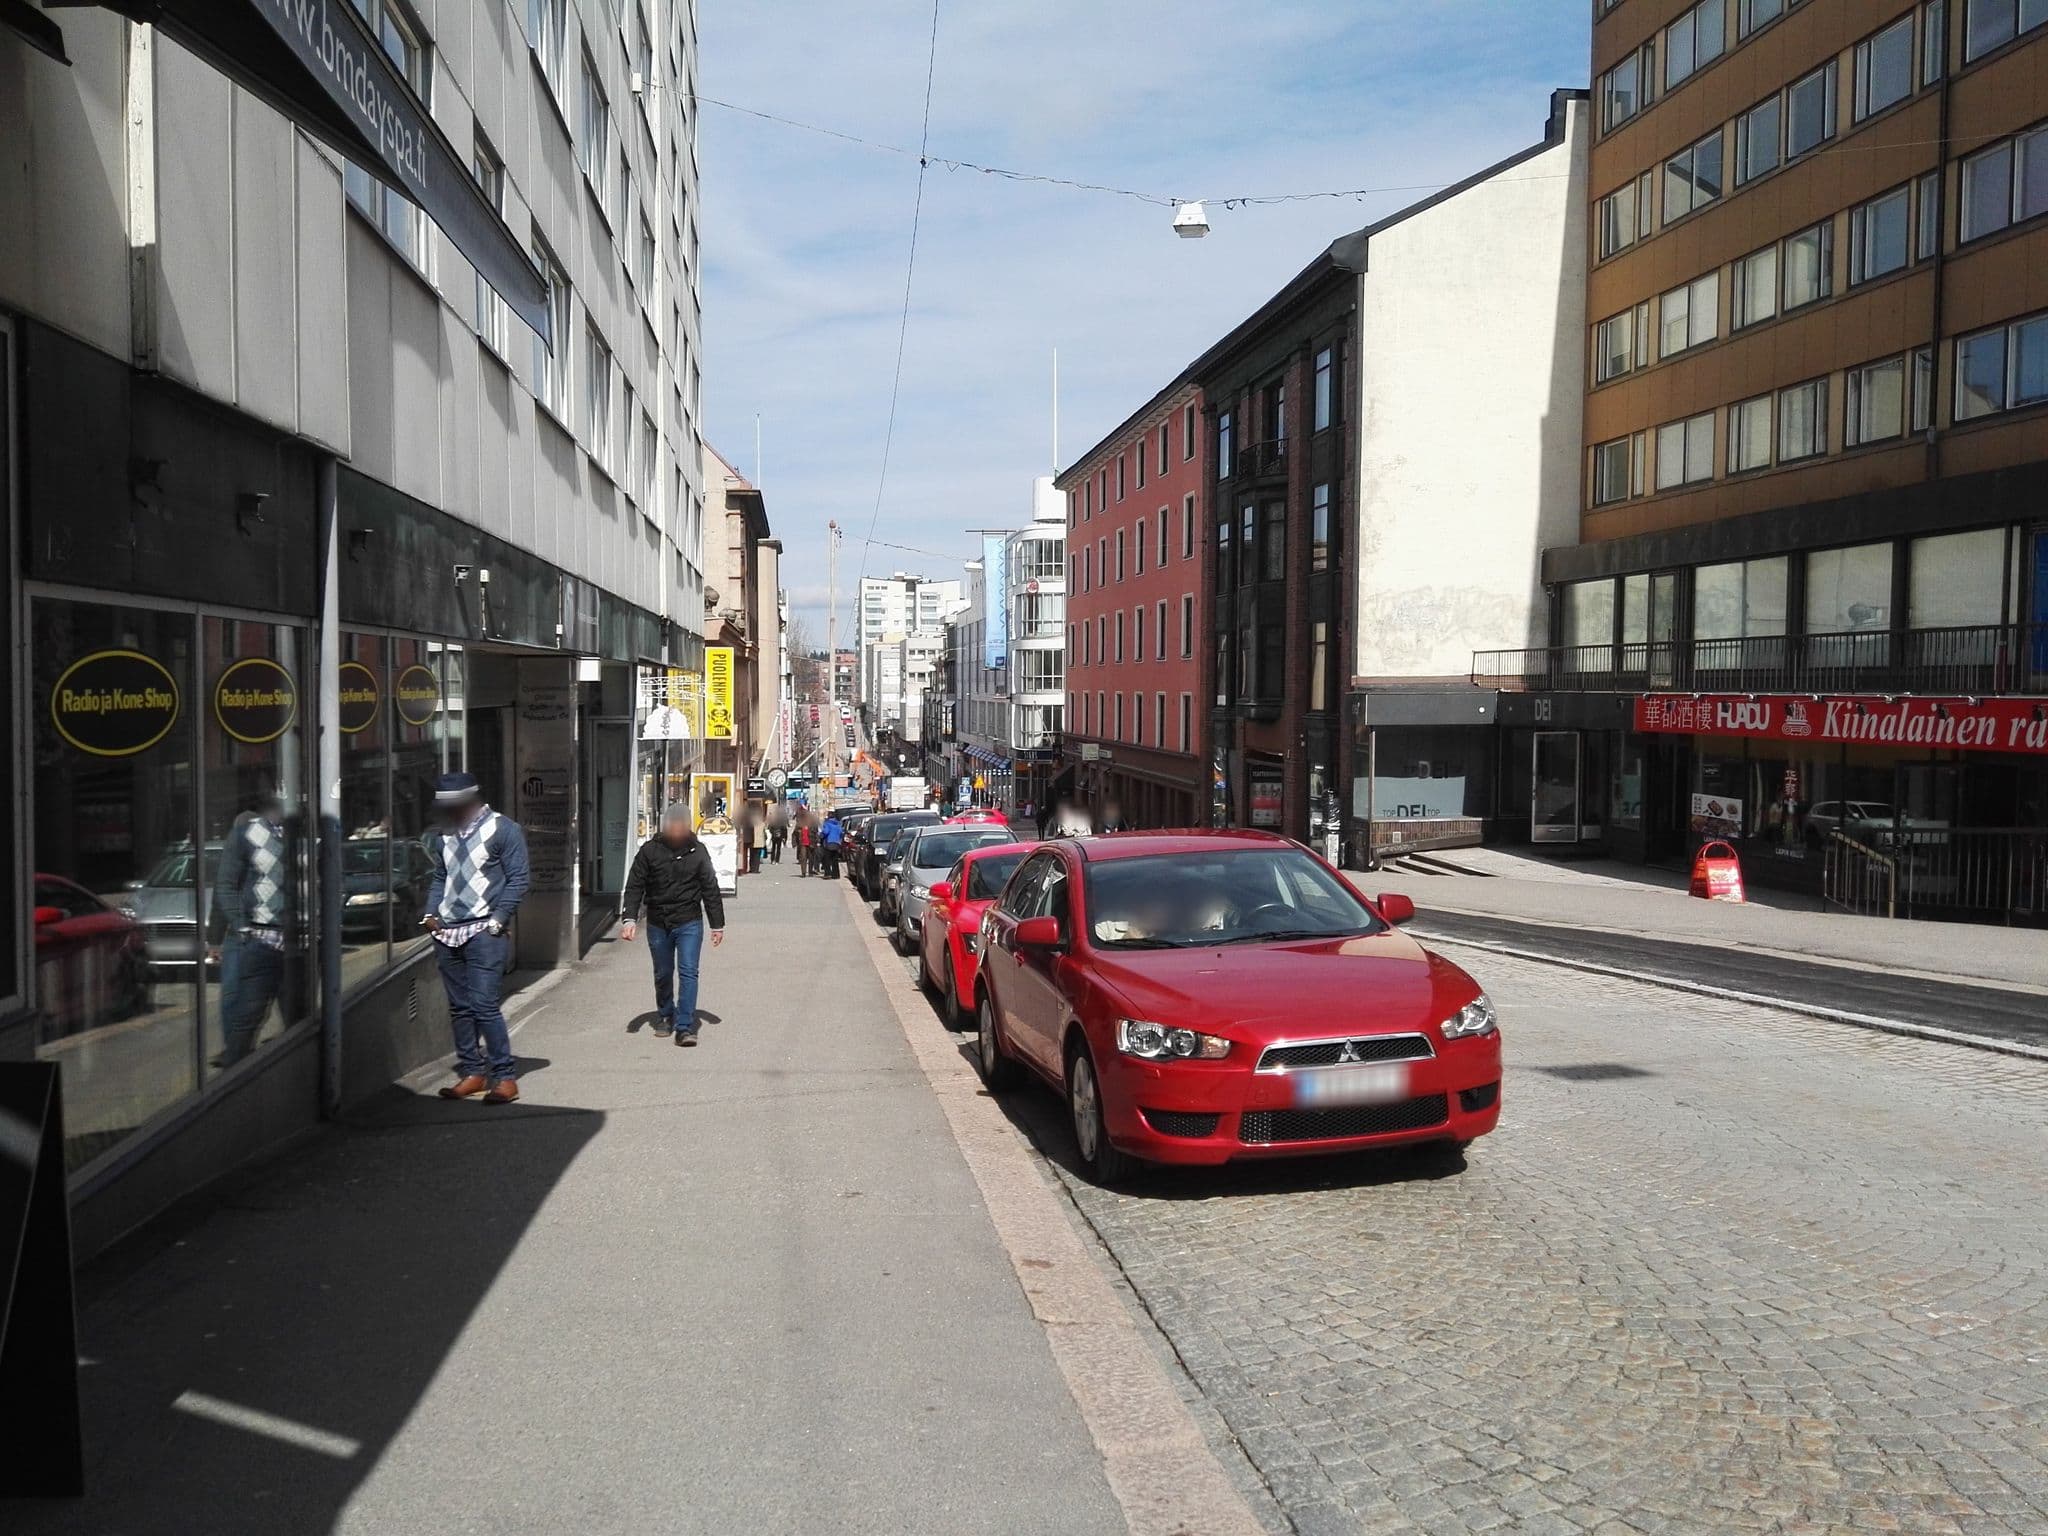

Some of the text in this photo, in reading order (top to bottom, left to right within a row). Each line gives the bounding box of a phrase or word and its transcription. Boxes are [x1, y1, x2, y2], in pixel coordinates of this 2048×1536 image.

[62, 687, 173, 715] Radio ja Kone Shop
[221, 688, 245, 707] Radio
[253, 688, 274, 706] Kone
[274, 687, 292, 708] Shop
[1534, 698, 1551, 721] DEI
[1645, 699, 1712, 730] 華都酒樓
[1821, 701, 1996, 746] Kiinalainen
[1382, 809, 1397, 818] TOP
[1427, 808, 1441, 817] TOP
